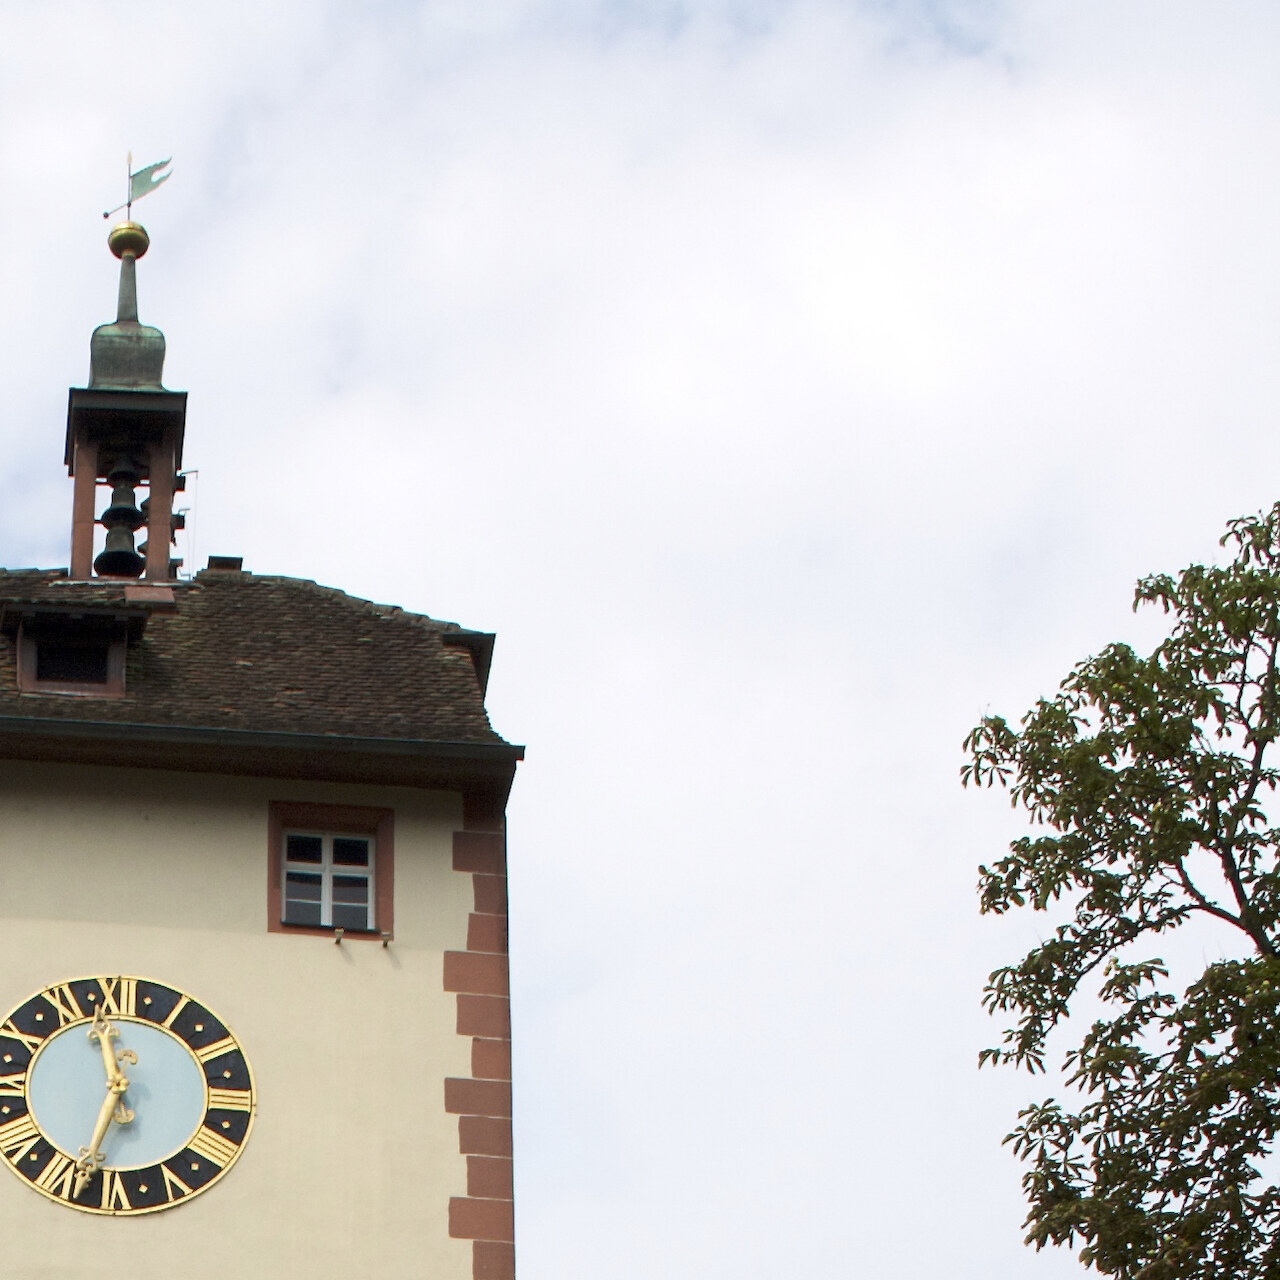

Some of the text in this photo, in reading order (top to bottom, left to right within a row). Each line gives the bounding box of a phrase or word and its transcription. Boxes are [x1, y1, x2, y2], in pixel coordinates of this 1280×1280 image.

[41, 983, 86, 1027] XI
[96, 978, 138, 1016] XII
[161, 994, 192, 1028] I
[193, 1035, 239, 1064] II
[208, 1086, 252, 1113] III
[33, 1151, 77, 1200] VII
[100, 1171, 132, 1210] VI
[161, 1164, 194, 1202] V
